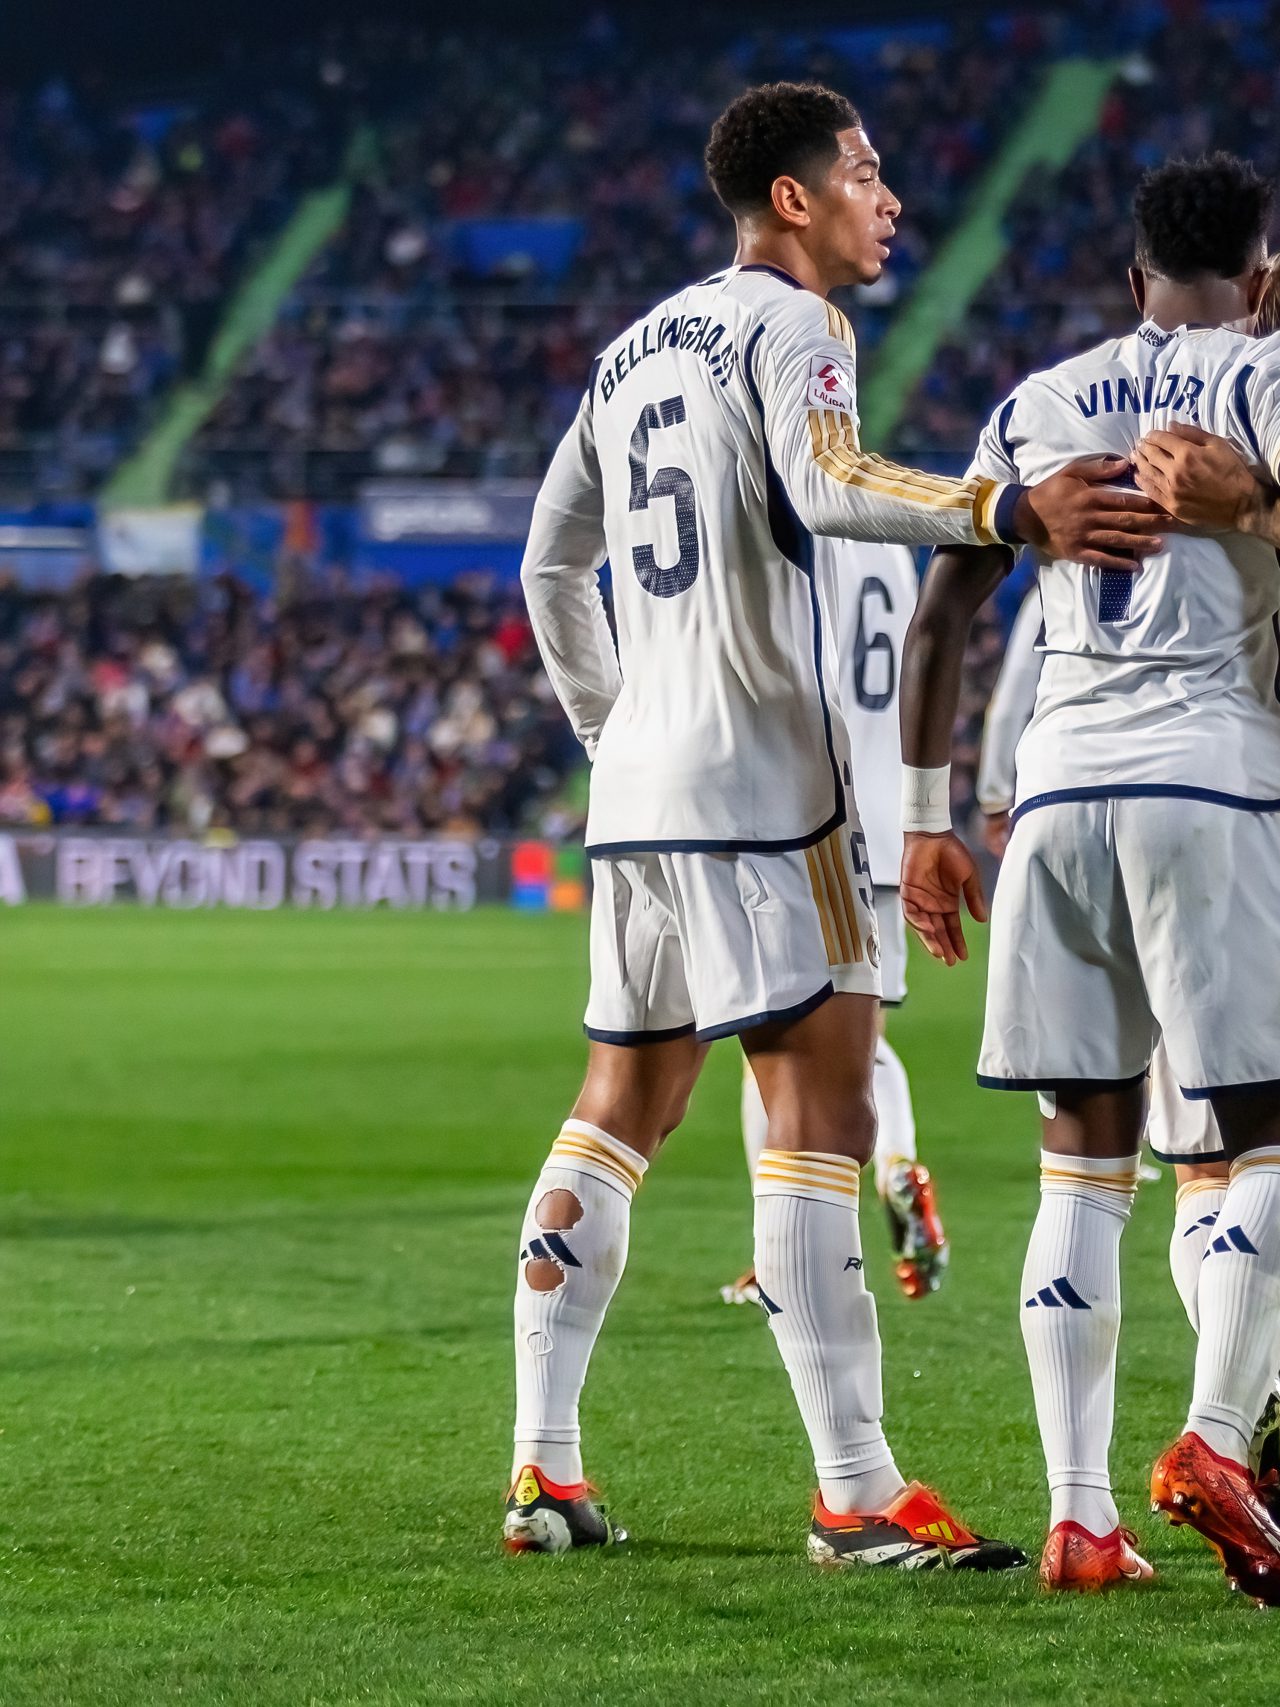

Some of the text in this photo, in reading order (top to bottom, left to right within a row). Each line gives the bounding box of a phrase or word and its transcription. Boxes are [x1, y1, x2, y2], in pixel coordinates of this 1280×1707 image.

[814, 388, 846, 409] LALIGA
[1074, 376, 1154, 418] VINI
[629, 395, 699, 599] 5
[855, 577, 894, 711] 6
[56, 838, 286, 910] BEYOND
[292, 838, 477, 911] STATS
